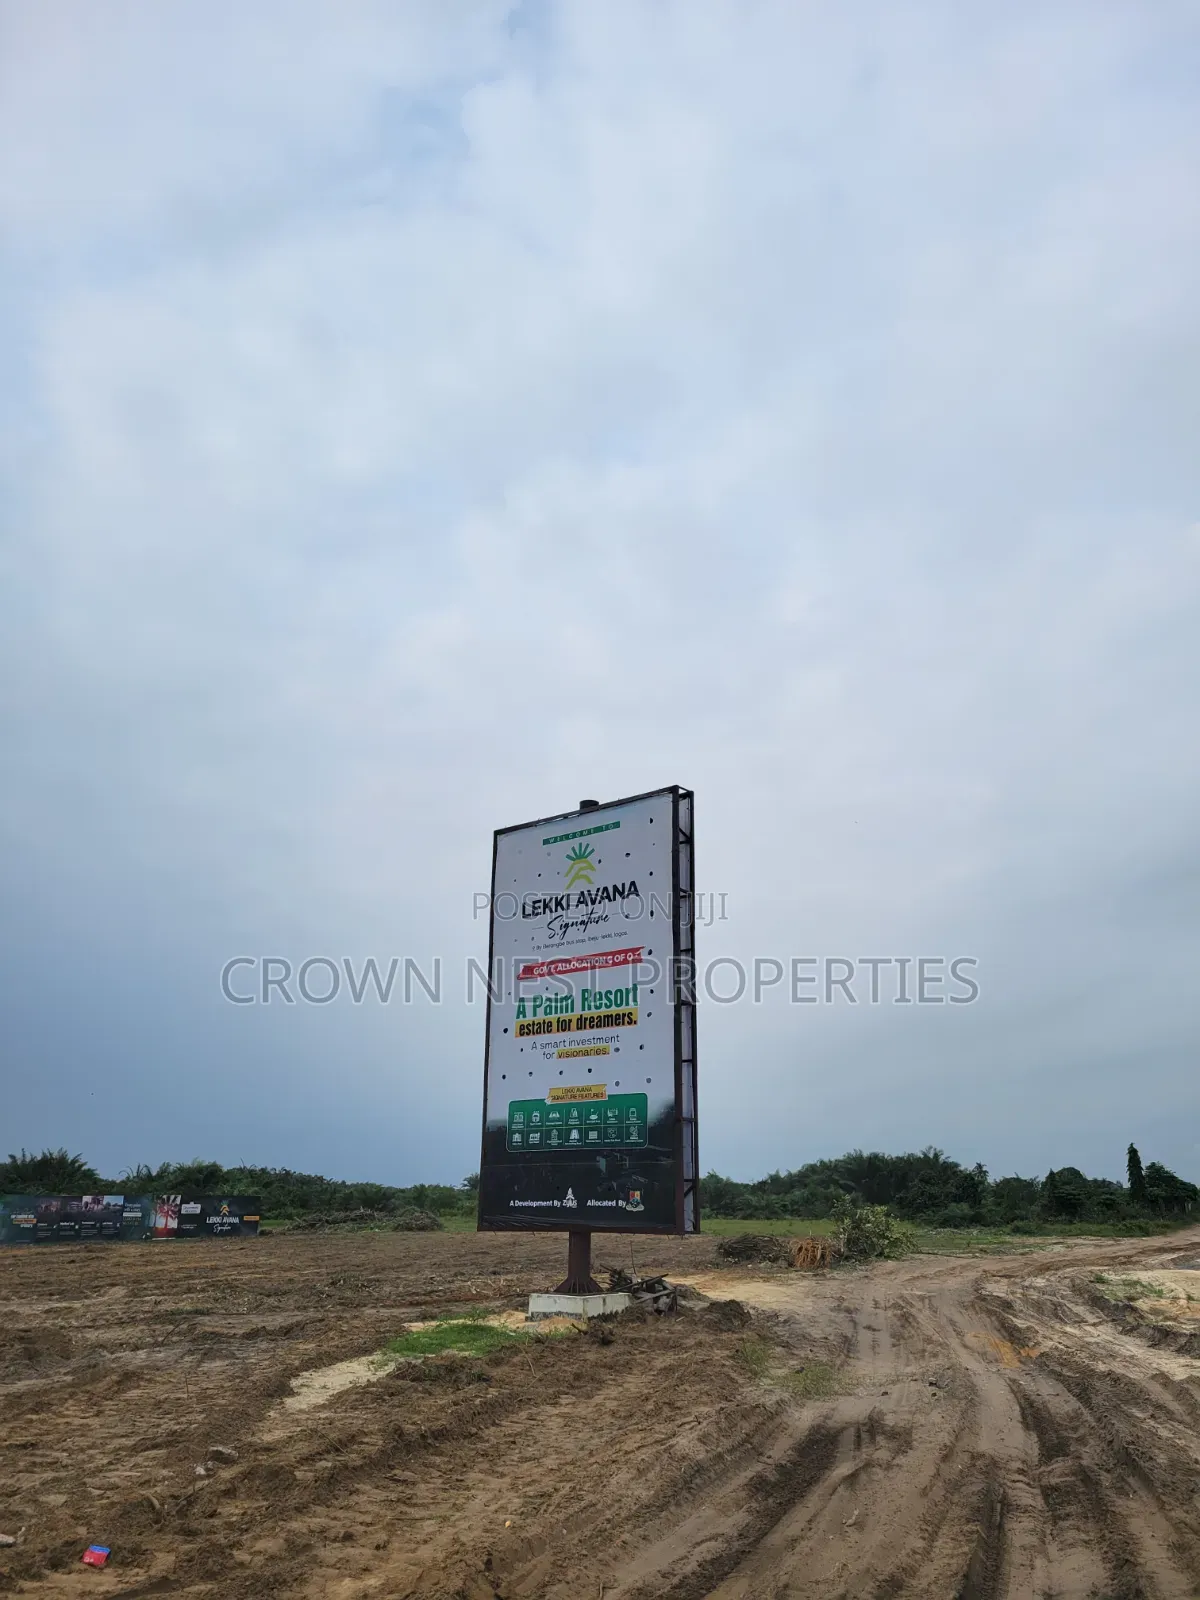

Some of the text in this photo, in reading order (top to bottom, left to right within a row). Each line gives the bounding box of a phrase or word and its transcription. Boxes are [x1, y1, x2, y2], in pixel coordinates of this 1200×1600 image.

[548, 829, 595, 844] WELCOME
[522, 880, 640, 919] LEKKI AVANA
[546, 909, 611, 940] Signature
[557, 957, 607, 972] ALLOCATION
[614, 953, 627, 962] OF
[515, 983, 638, 1019] A Palm Resort
[518, 1011, 638, 1037] estate for dreamers.
[531, 1033, 620, 1050] A smart investment
[543, 1045, 610, 1060] for visionaries.
[514, 1200, 553, 1208] Development
[554, 1200, 561, 1208] By
[587, 1199, 626, 1208] Allocated By
